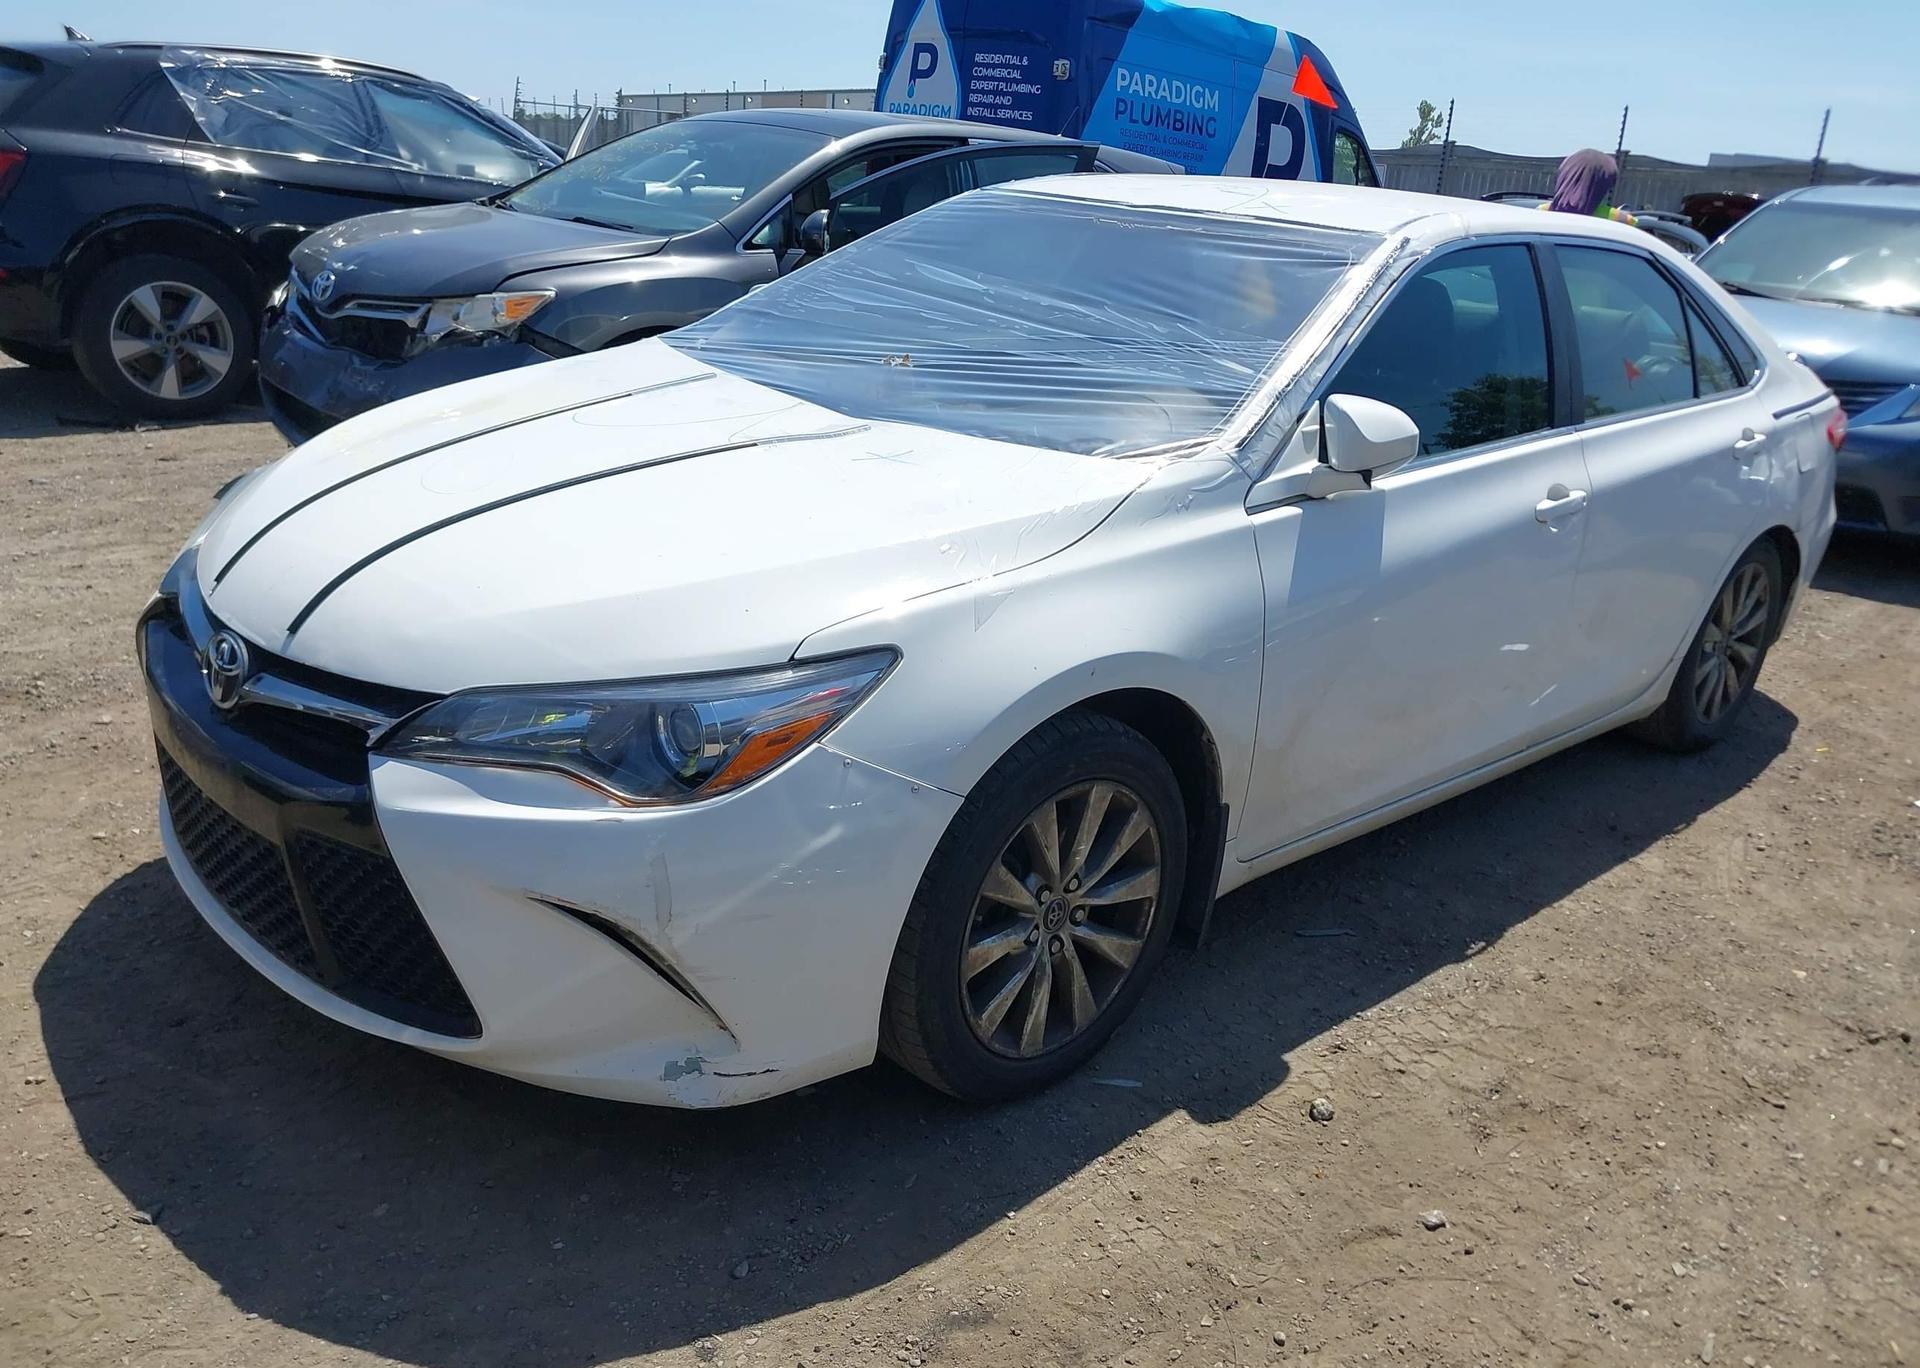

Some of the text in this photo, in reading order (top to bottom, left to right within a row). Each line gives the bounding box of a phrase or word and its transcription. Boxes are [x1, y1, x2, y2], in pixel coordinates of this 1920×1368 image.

[908, 42, 939, 86] P
[974, 53, 1029, 65] RESIDENTIAL &
[972, 66, 1022, 79] COMMERCIAL
[970, 80, 1041, 94] EXPERT PLUMBING
[1116, 67, 1219, 112] PARADIGM
[968, 94, 1012, 105] REPAIR AND
[889, 102, 952, 118] PARADIGM
[967, 107, 1033, 121] INSTALL SERVICES
[1114, 97, 1217, 138] PLUMBING
[1120, 127, 1161, 143] RESIDENTIAL
[1168, 136, 1208, 152] COMMERCIAL
[1149, 144, 1182, 159] PLUMBING
